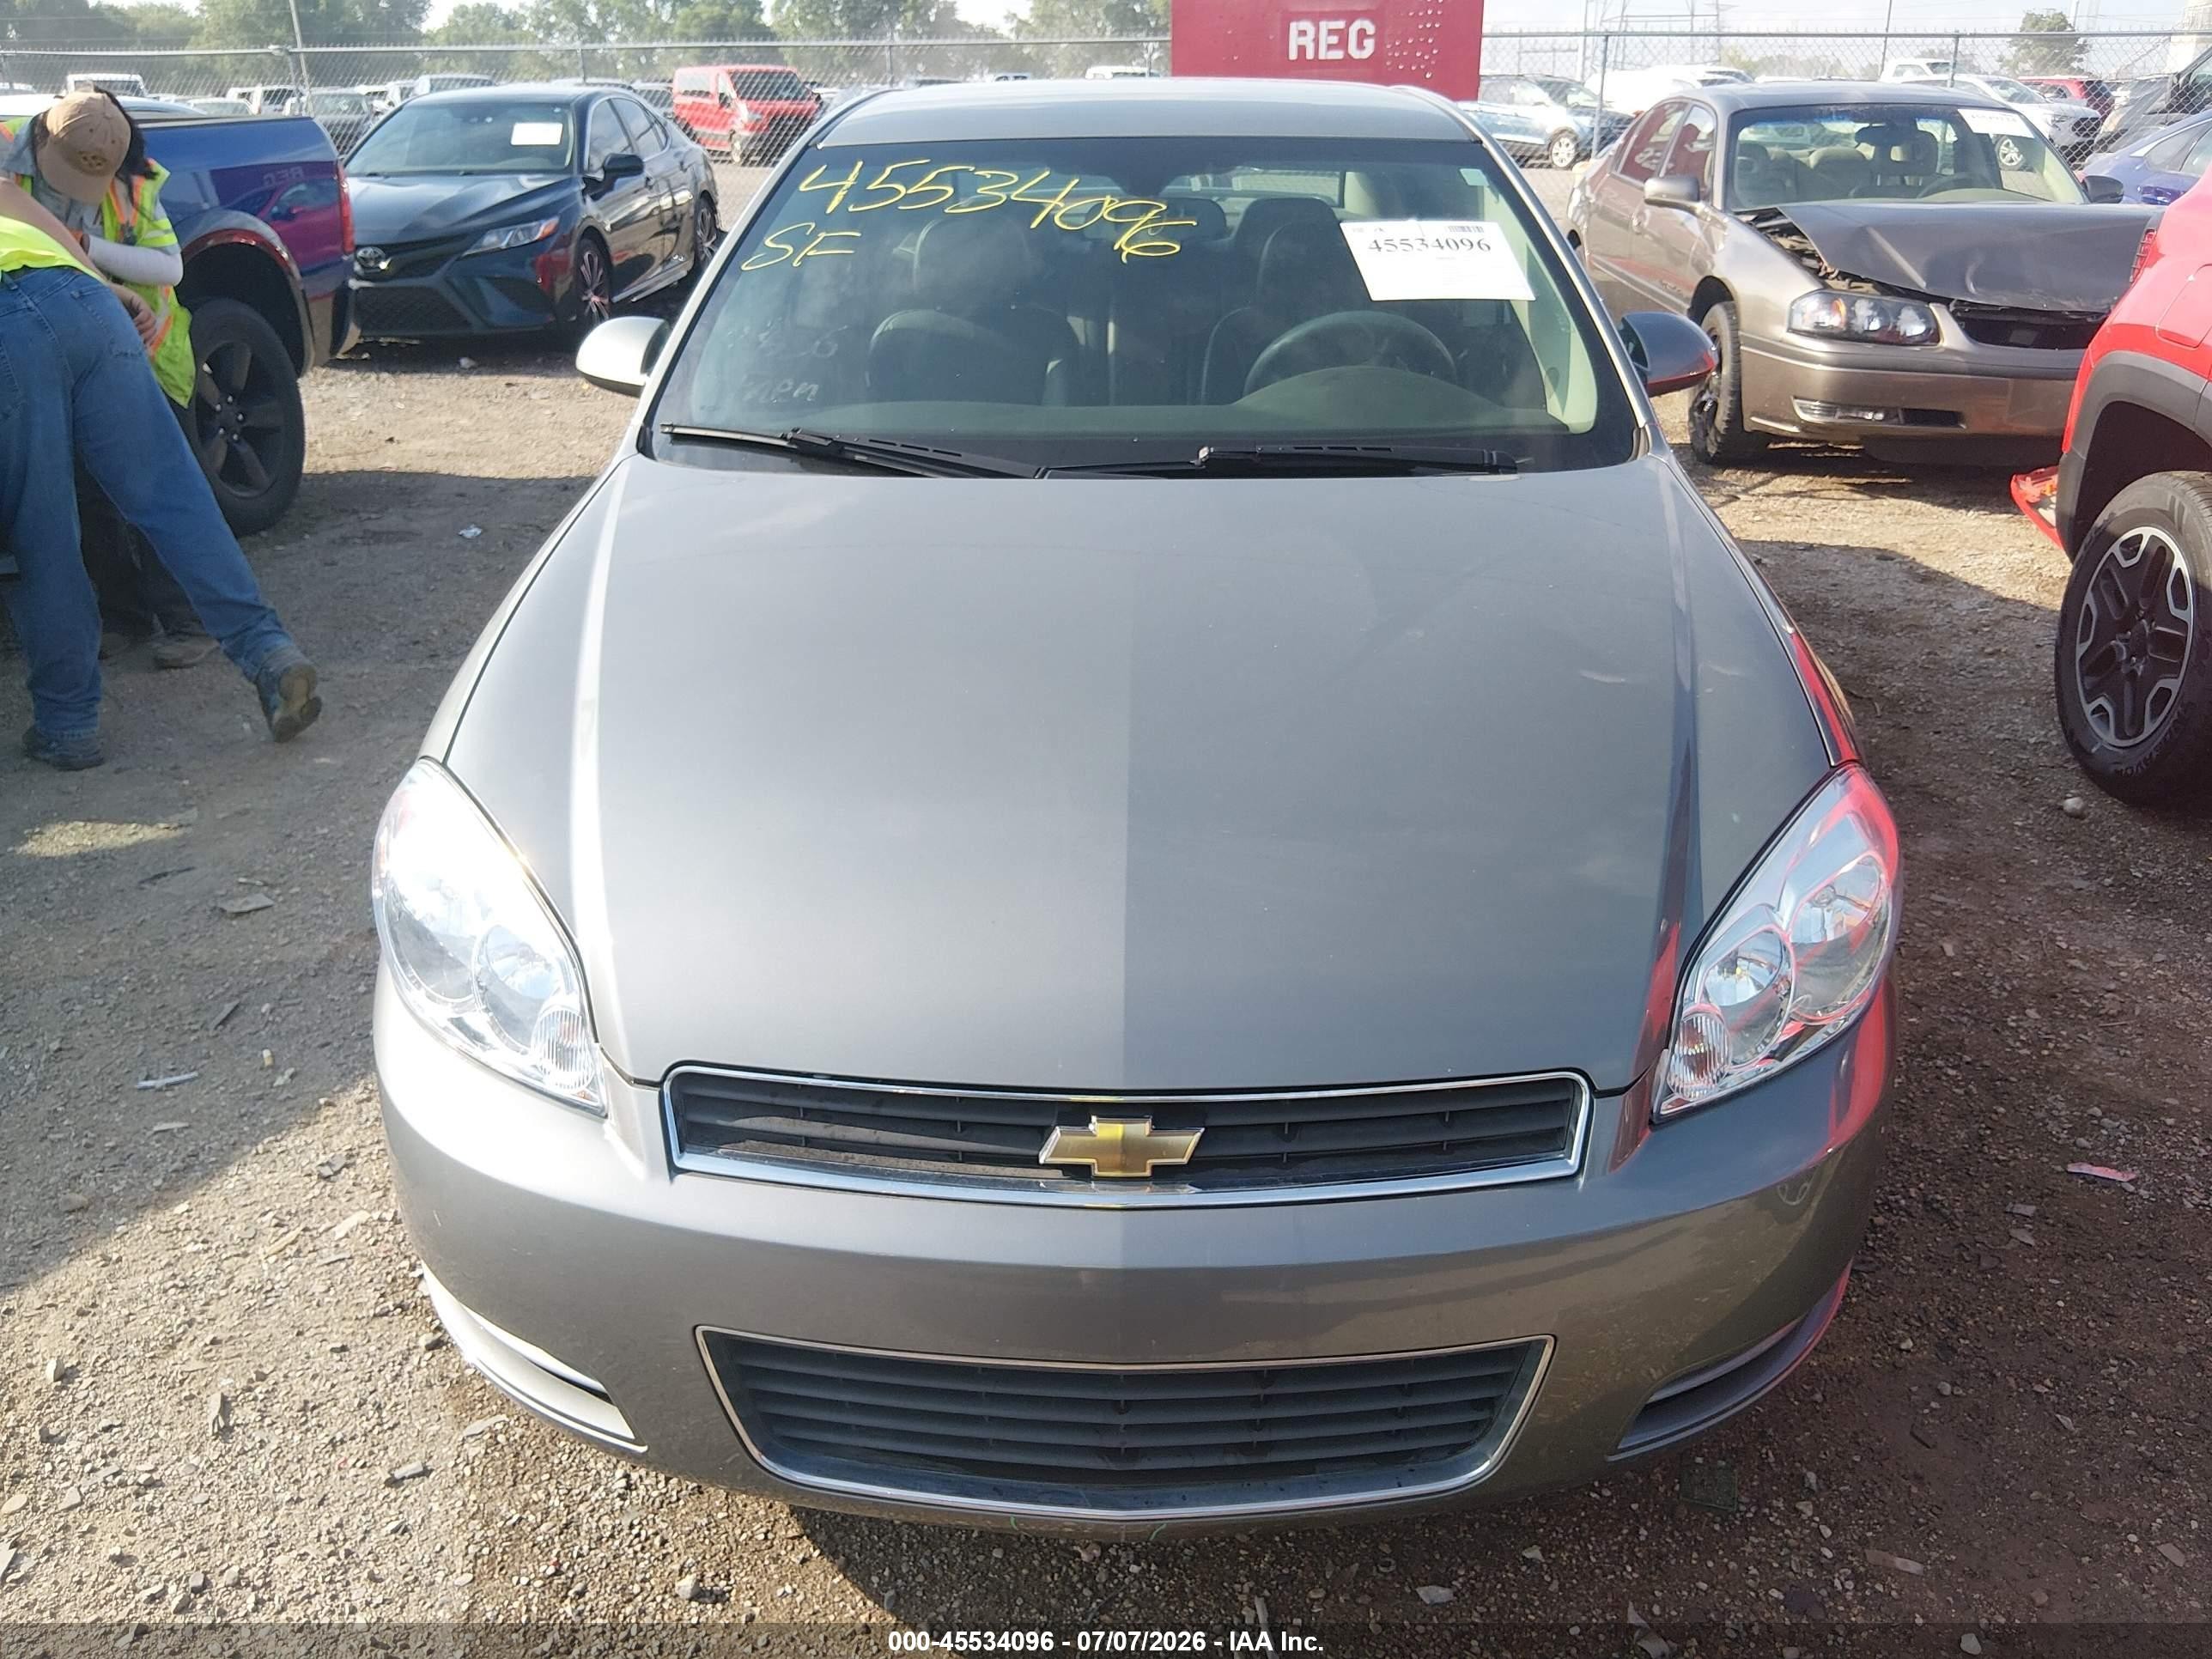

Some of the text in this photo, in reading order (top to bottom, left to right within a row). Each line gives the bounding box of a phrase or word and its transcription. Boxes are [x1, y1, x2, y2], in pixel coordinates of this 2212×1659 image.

[1288, 20, 1376, 60] REG
[799, 160, 1197, 264] 45534096
[741, 222, 861, 270] SF
[1368, 238, 1492, 252] 45534096
